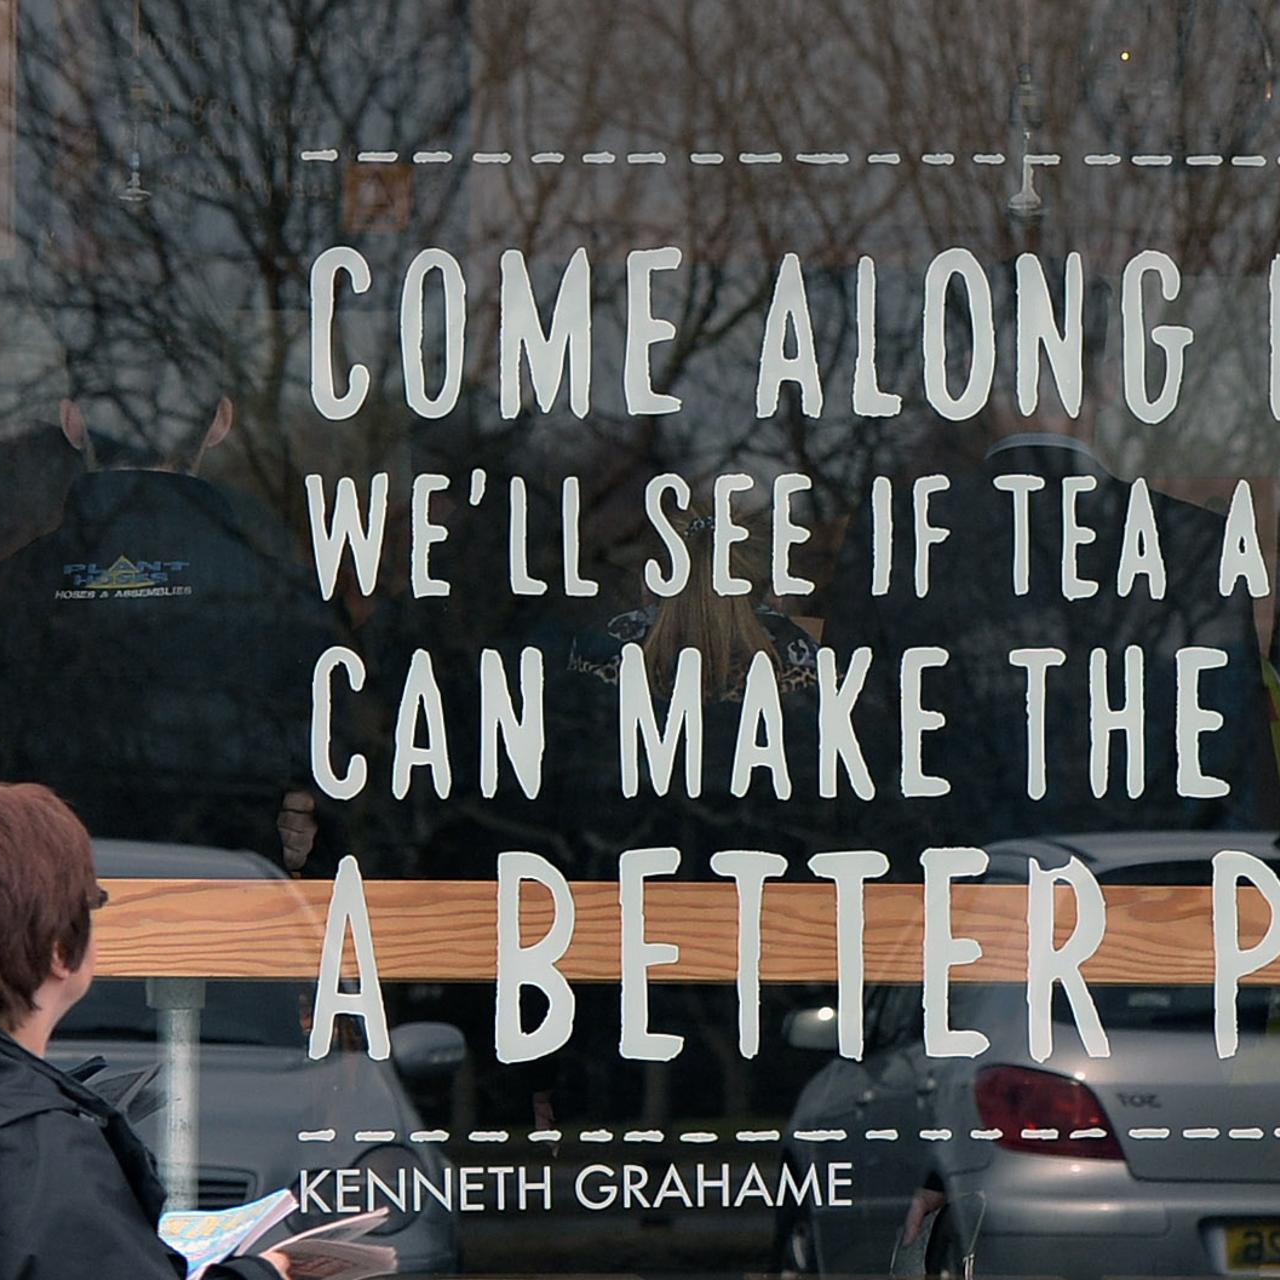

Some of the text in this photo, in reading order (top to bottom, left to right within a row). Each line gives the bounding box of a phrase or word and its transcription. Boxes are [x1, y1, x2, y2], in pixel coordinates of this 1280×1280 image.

[311, 247, 682, 420] COME
[757, 248, 1194, 424] ALONG
[55, 589, 96, 600] HOSES
[305, 470, 599, 601] WE'LL
[645, 473, 815, 597] SEE
[871, 474, 950, 598] IF
[993, 475, 1167, 600] TEA
[312, 646, 545, 800] CAN
[620, 643, 951, 801] MAKE
[1009, 646, 1230, 800] THE
[308, 856, 391, 1062] A
[495, 848, 1111, 1064] BETTER
[298, 1163, 854, 1213] KENNETH GRAHAME
